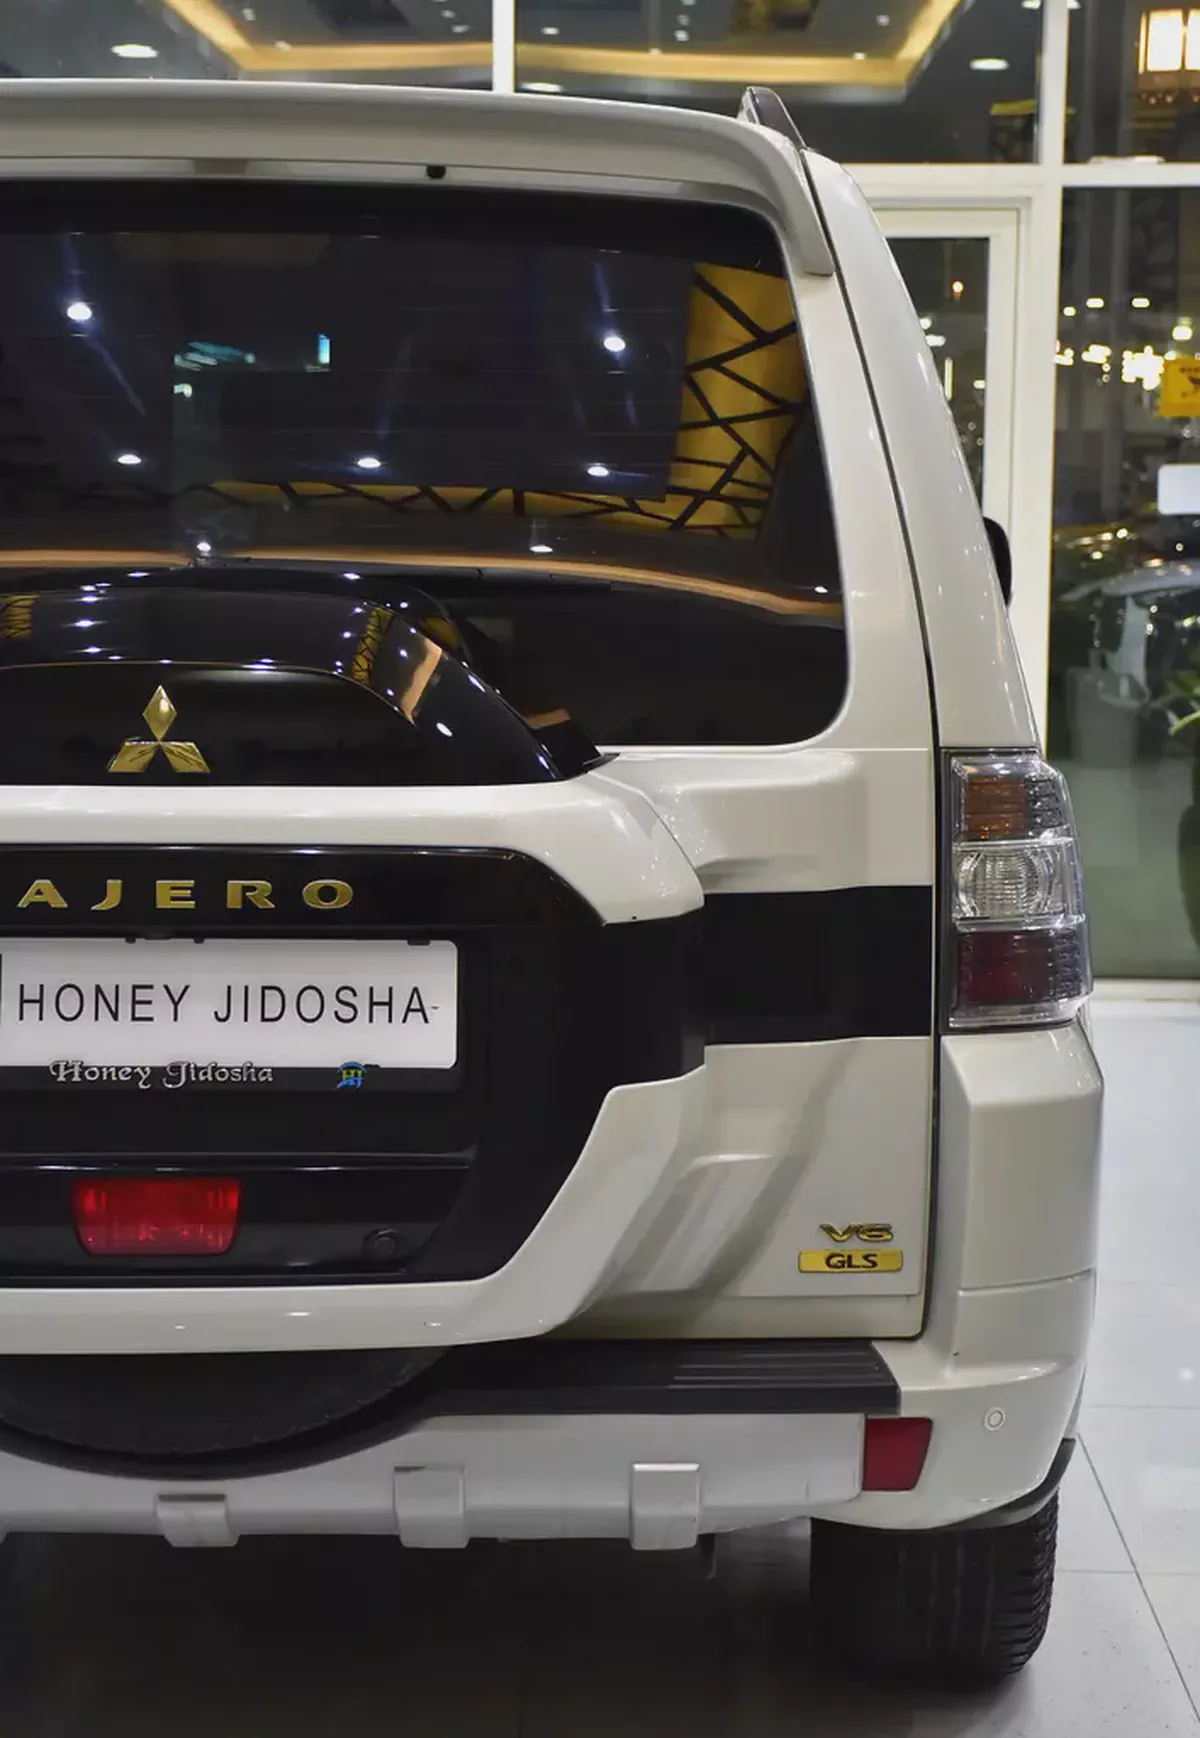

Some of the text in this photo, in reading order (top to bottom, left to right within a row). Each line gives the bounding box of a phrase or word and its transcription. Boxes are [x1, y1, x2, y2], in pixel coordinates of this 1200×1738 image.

[17, 879, 354, 910] AJERO
[18, 983, 191, 1023] HONEY
[49, 1060, 274, 1089] Honey Jidosha
[819, 1222, 894, 1243] V6
[824, 1253, 878, 1269] GLS
